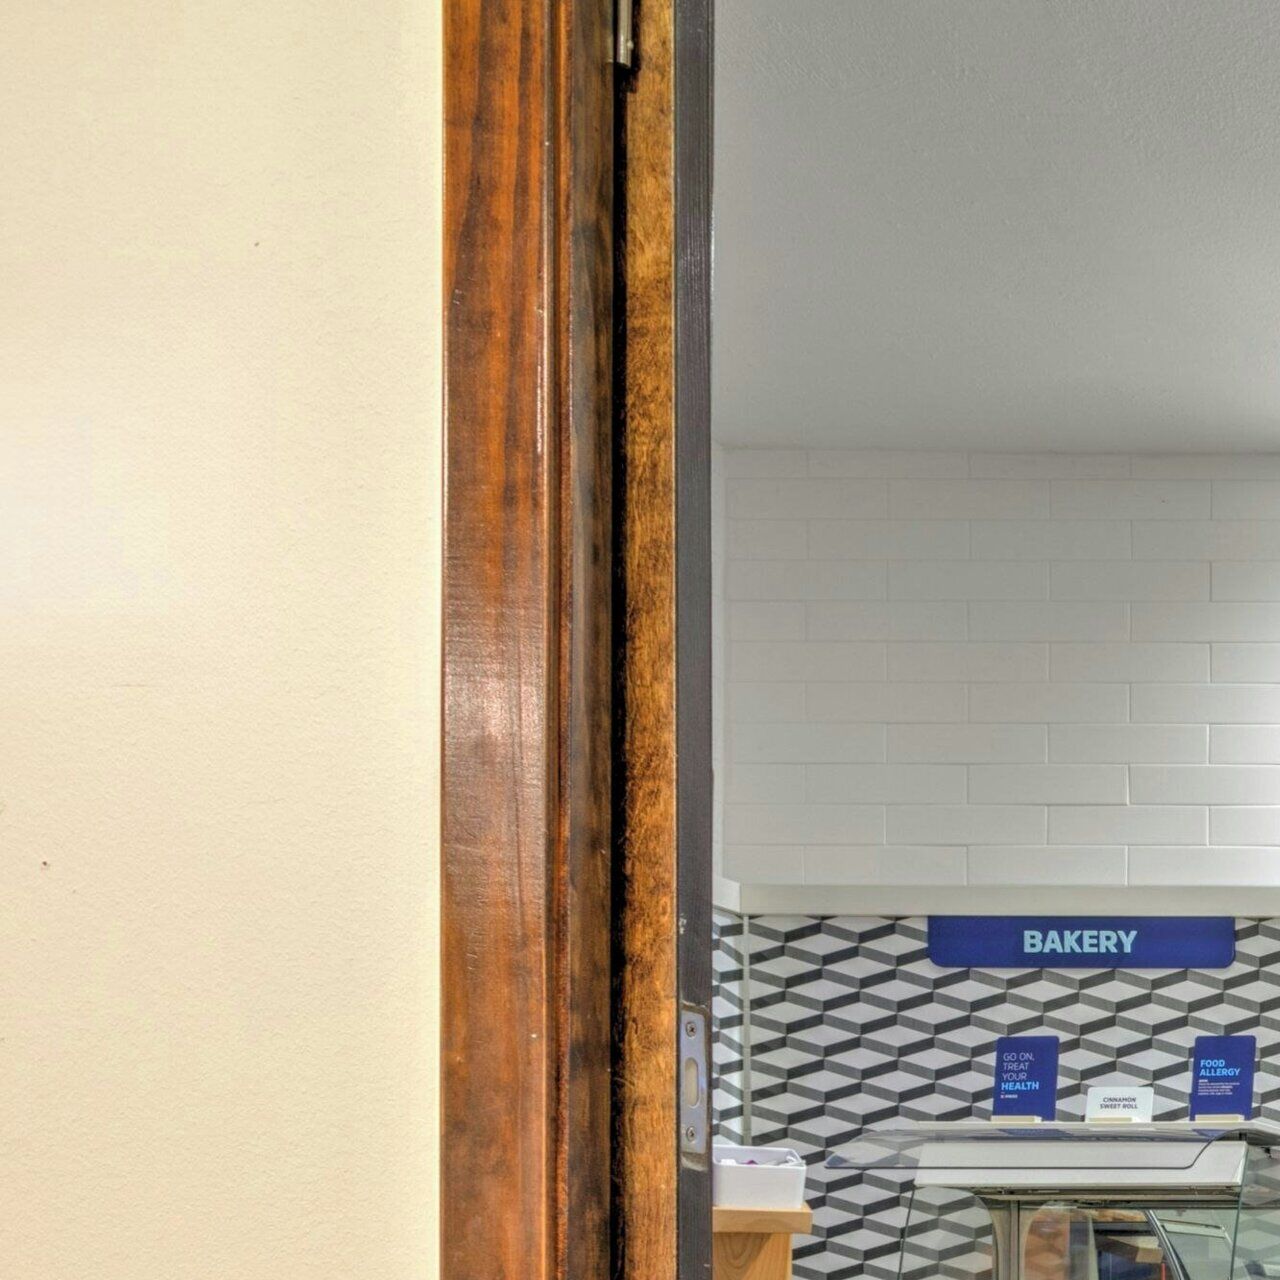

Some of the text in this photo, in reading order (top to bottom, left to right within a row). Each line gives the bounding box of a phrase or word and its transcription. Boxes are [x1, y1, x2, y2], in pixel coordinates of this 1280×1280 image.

[1023, 930, 1138, 954] BAKERY
[1003, 1052, 1017, 1062] GO
[1003, 1062, 1030, 1071] TREAT
[1200, 1059, 1225, 1068] FOOD
[1002, 1072, 1027, 1081] YOUR
[1199, 1068, 1241, 1077] ALLERGY
[1001, 1081, 1040, 1091] HEALTH
